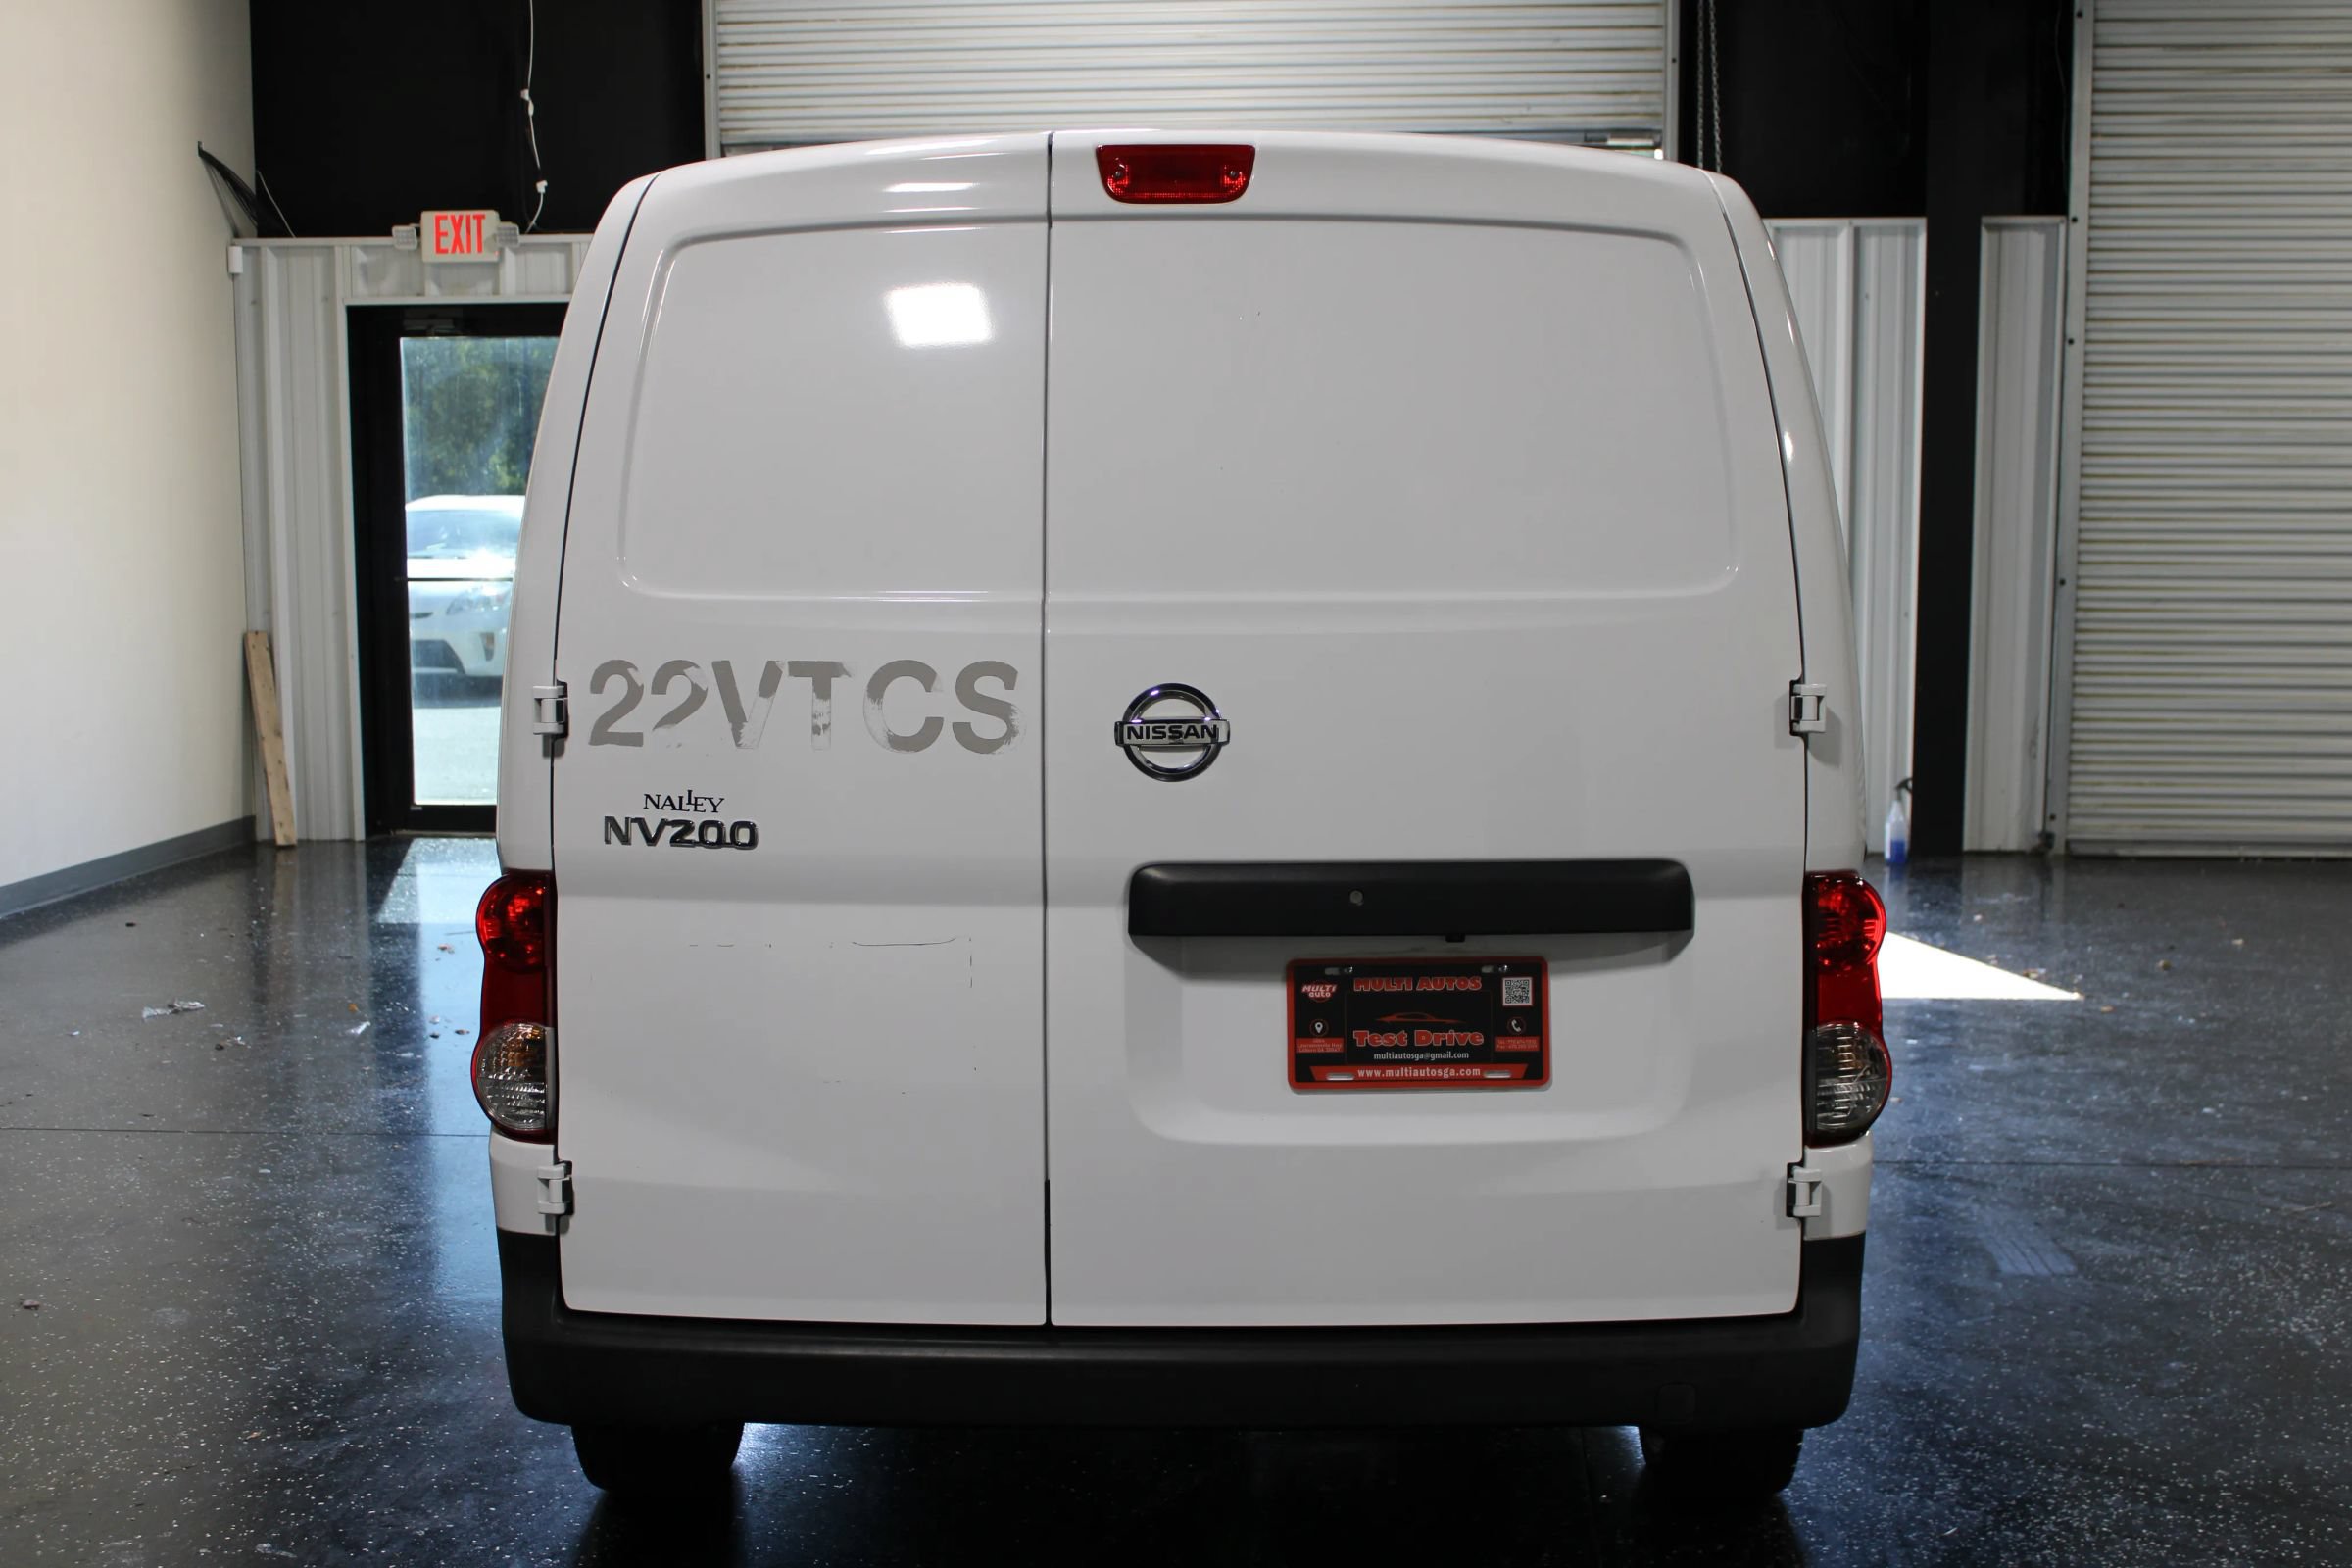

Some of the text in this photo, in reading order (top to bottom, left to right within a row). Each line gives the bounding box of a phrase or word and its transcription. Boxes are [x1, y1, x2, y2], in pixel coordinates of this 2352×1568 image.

[434, 213, 486, 254] EXIT
[588, 659, 1024, 755] 22VTCS
[1126, 724, 1218, 740] NISSAN
[643, 789, 724, 812] NALLEY
[604, 815, 760, 850] NV200
[1353, 976, 1483, 992] MULTI AUTOS
[1352, 1029, 1485, 1047] Test Drive
[1373, 1051, 1469, 1061] multiautosga@gmail.com
[1357, 1066, 1481, 1079] www.multiautosga.com
